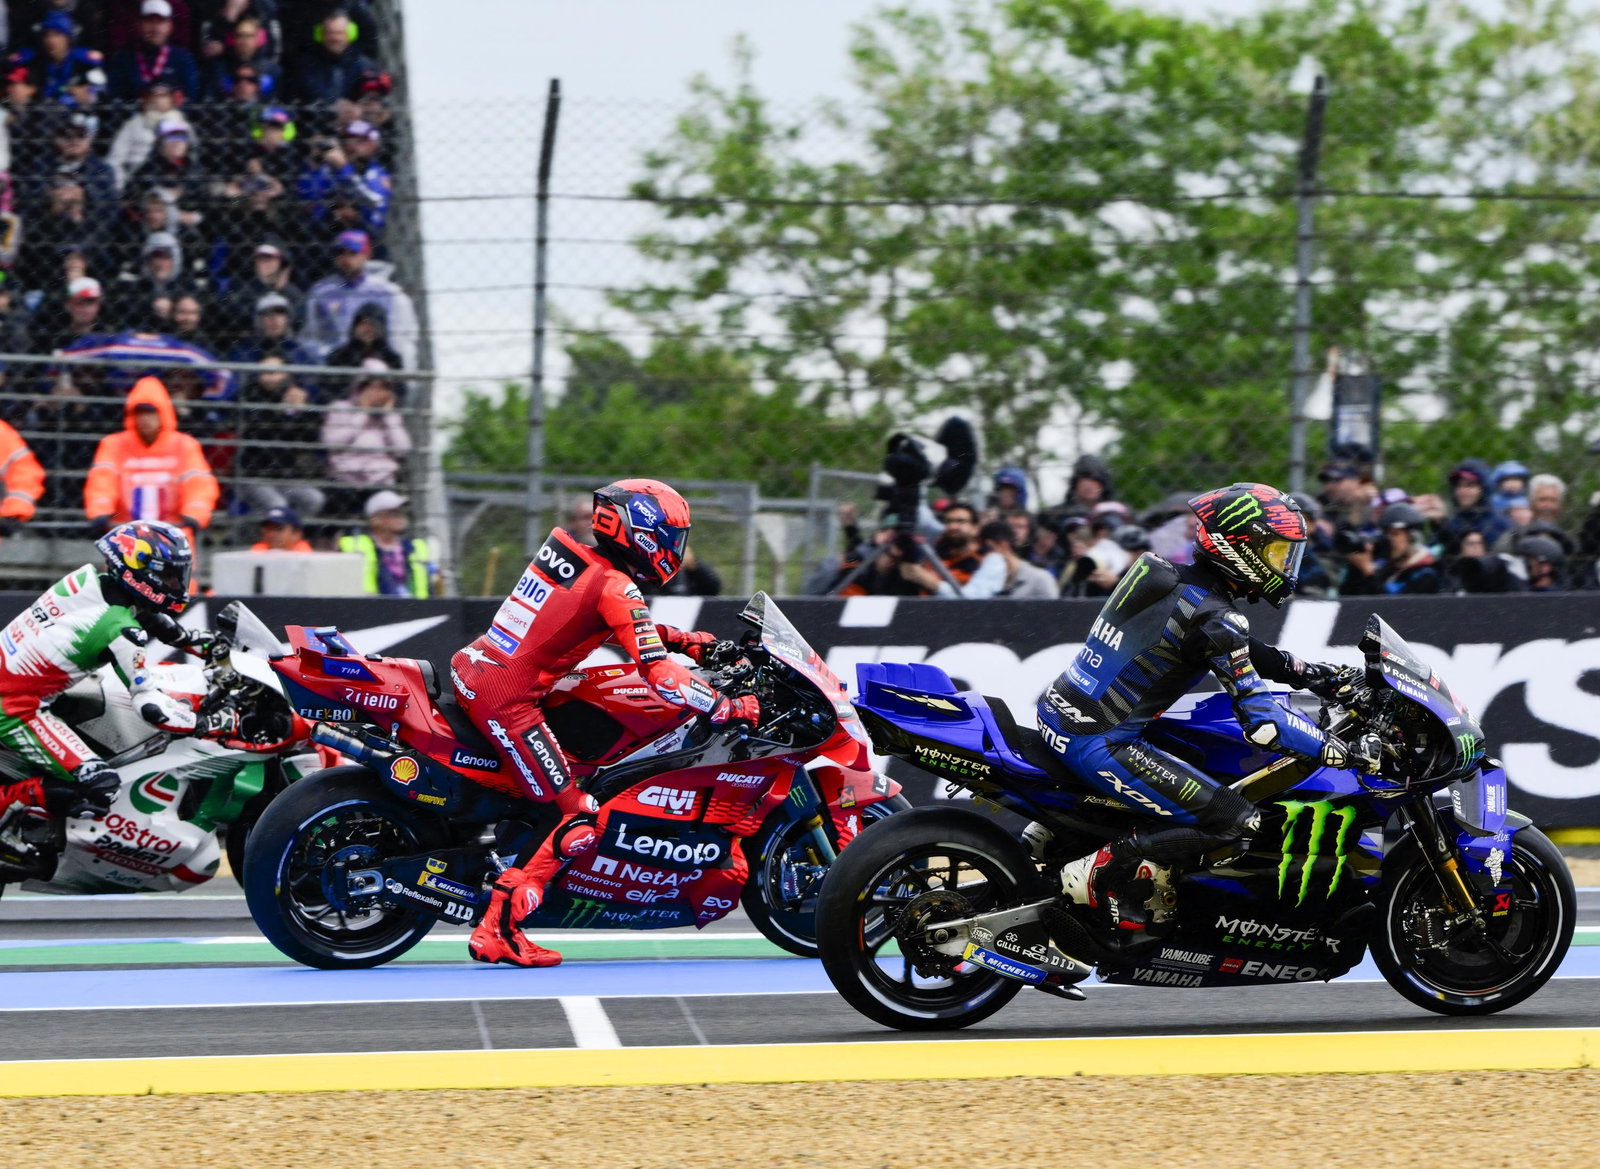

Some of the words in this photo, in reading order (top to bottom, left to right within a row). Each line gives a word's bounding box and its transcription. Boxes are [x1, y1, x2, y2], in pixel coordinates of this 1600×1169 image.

[636, 534, 656, 552] SHOEI
[1207, 532, 1262, 583] SCORPION
[1239, 542, 1272, 578] MONSTER
[341, 666, 361, 675] TIM
[1392, 668, 1427, 691] Roboze
[613, 687, 648, 695] DUCATI
[1396, 680, 1429, 702] YAMAHA
[300, 708, 358, 721] FLEX-BOX
[28, 719, 67, 761] HONDA
[454, 752, 498, 769] Lenovo
[487, 719, 544, 798] alpinestars
[527, 730, 564, 786] Lenovo
[914, 745, 991, 775] MONSTER
[919, 756, 978, 778] ENERGY
[1126, 745, 1178, 785] MONSTER
[716, 772, 766, 784] DUCATI
[1127, 757, 1165, 785] ENERGY
[636, 785, 697, 811] GIVI
[98, 813, 182, 855] astrol
[614, 823, 721, 865] Lenovo
[438, 881, 476, 898] MICHELIN
[568, 869, 622, 888] streparava
[402, 887, 443, 908] Reflexallen
[567, 882, 614, 900] SIEMENS
[1215, 915, 1341, 954] MONSTER
[996, 939, 1021, 953] GILLES
[1160, 947, 1213, 965] YAMALUBE
[986, 958, 1039, 980] MICHELIN
[1131, 967, 1203, 988] YAMAHA
